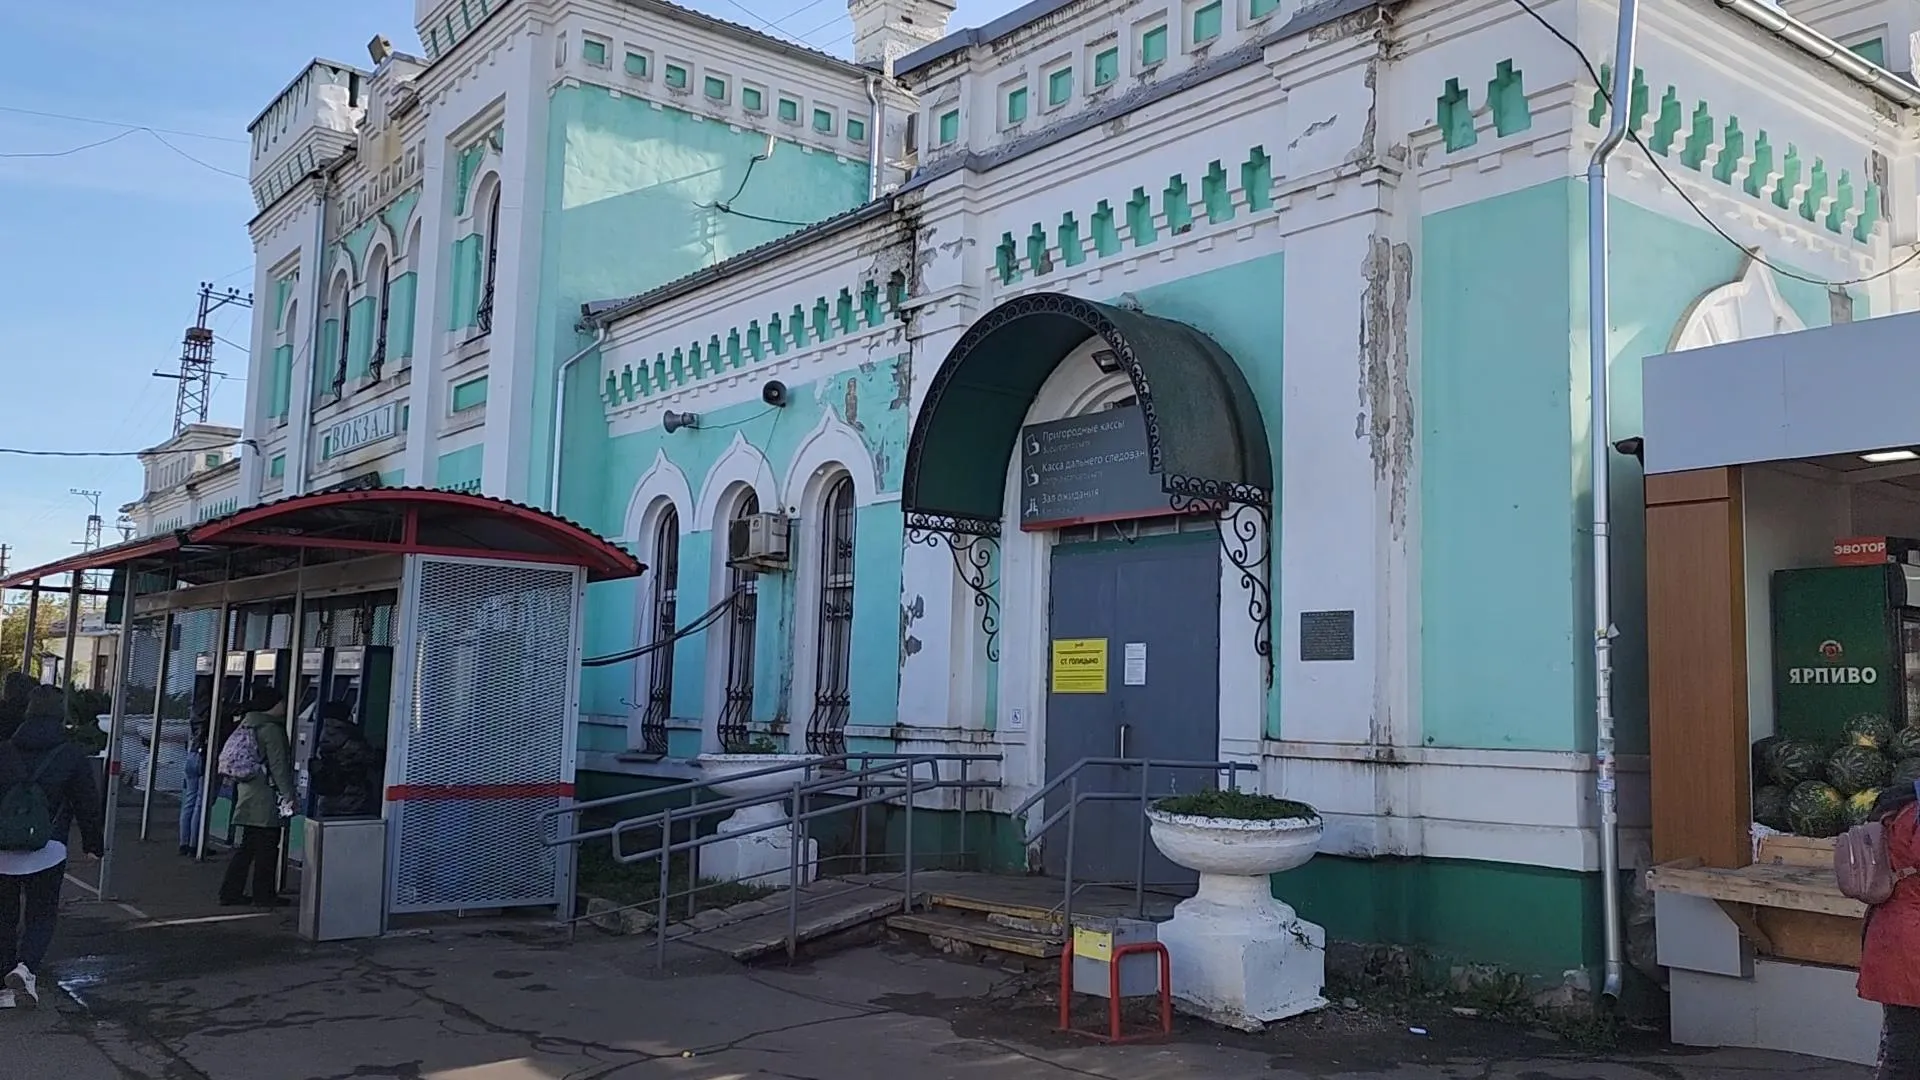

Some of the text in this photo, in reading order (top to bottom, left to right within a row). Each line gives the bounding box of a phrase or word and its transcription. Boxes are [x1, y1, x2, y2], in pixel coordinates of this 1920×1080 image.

[332, 406, 393, 452] ВОКЗАЛ
[1042, 419, 1125, 442] Пригородные кассы
[1041, 449, 1145, 473] Касса дальнего следован
[1834, 542, 1886, 555] ЭВОТОР
[1788, 666, 1878, 685] ЯРПИВО
